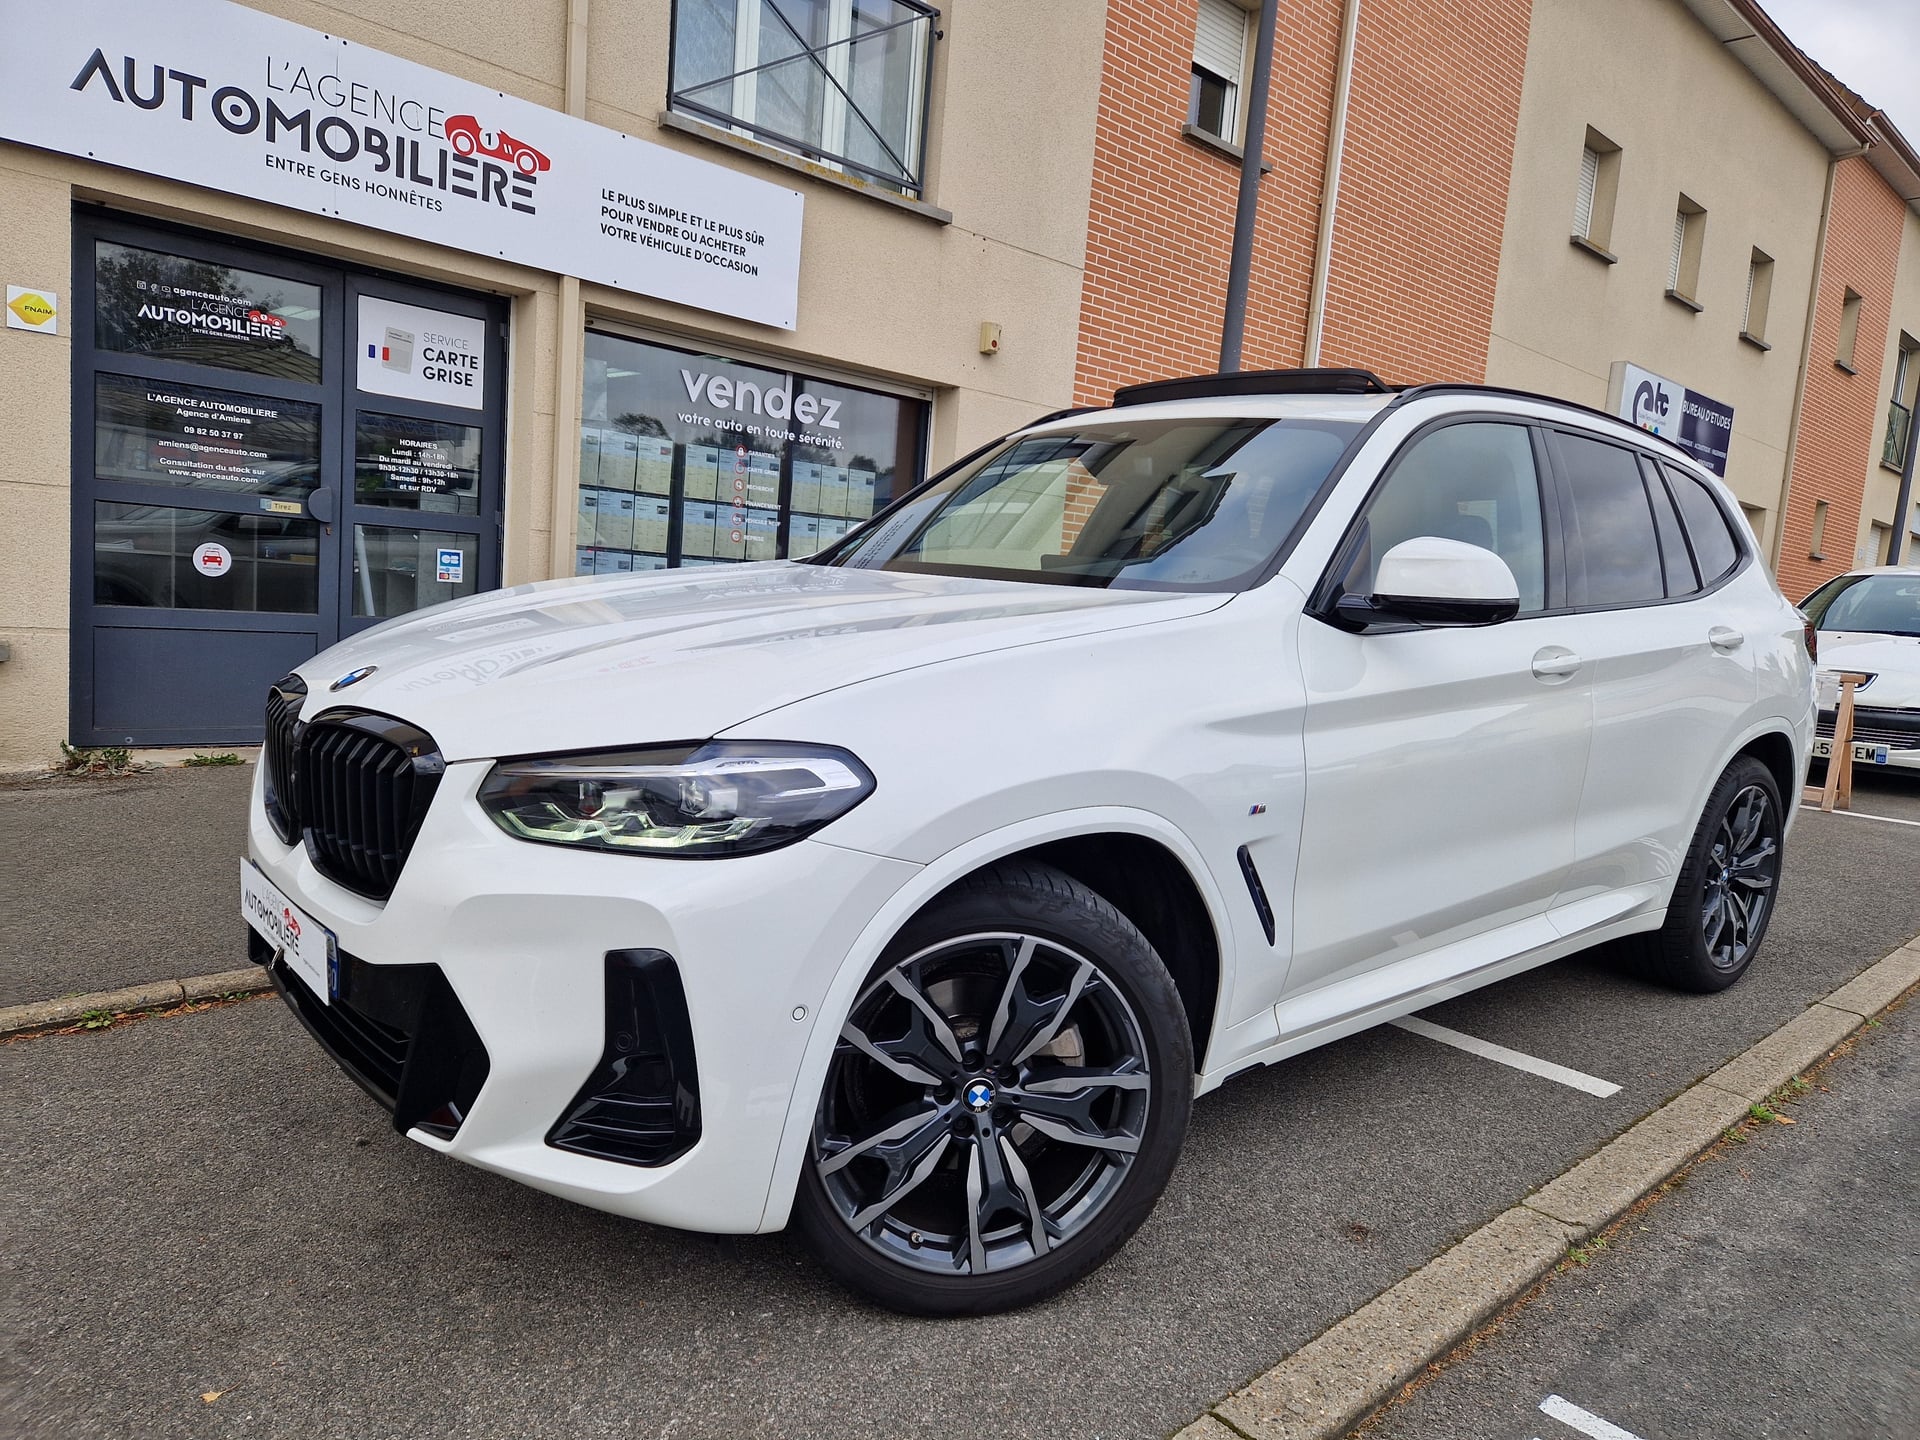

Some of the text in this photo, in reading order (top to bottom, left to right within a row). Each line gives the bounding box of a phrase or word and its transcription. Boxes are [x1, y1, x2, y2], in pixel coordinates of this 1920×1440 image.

[266, 56, 444, 140] L'AGENCE
[265, 154, 443, 212] ENTRE GENS HONNÊTES
[602, 188, 765, 246] LE PLUS SIMPLE ET LE PLUS SÛR
[601, 206, 746, 257] POUR VENDRE OU ACHETER
[600, 223, 758, 276] VOTRE VÉHICULE D'OCCASION
[173, 286, 252, 307] agenceauto.com
[24, 305, 52, 315] FNAIM
[191, 299, 249, 319] L'AGENCE
[423, 332, 469, 350] SERVICE
[423, 347, 479, 370] CARTE
[423, 366, 473, 387] GRISE
[147, 393, 278, 419] L'AGENCE AUTOMOBILIERE
[681, 368, 842, 429] vendez
[176, 408, 251, 425] Agence d'Amiens
[1682, 400, 1705, 421] BUREAU
[1705, 408, 1731, 430] D'ETUDES
[184, 425, 244, 440] 09 82 50 37 97
[678, 412, 711, 427] votre
[715, 418, 743, 433] auto
[746, 424, 761, 436] en
[765, 425, 795, 442] toute
[158, 439, 268, 459] amiens@agenceauto.com
[391, 448, 412, 456] Lundi
[399, 439, 437, 450] HORAIRES
[159, 457, 266, 476] Consultation du stock sur
[422, 461, 453, 470] vendredi
[168, 468, 258, 484] www.agenceauto.com
[390, 473, 417, 482] Samedi
[421, 485, 437, 493] RDV
[274, 503, 291, 511] Tirez
